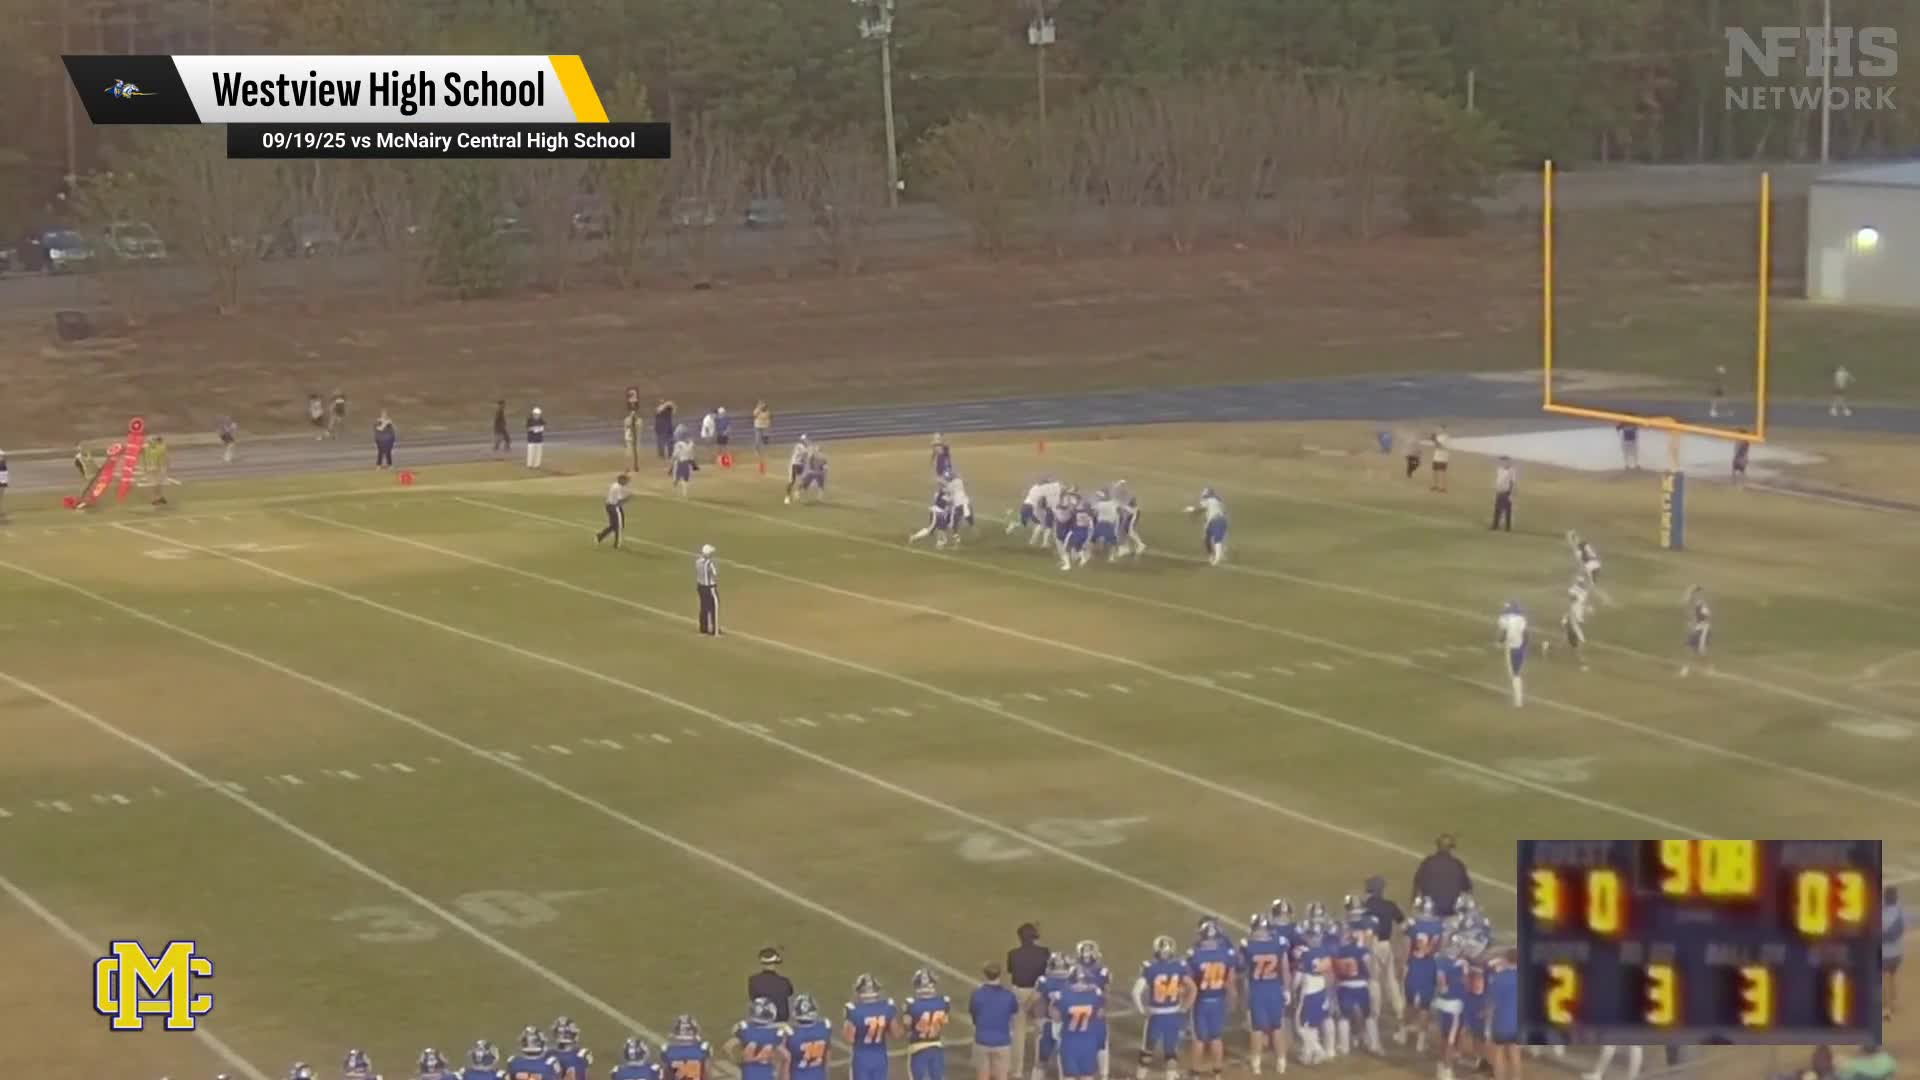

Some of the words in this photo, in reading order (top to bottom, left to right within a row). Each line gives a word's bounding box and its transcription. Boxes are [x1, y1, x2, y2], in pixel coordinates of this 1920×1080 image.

[1587, 869, 1619, 933] 0
[1796, 870, 1829, 935] 0
[1252, 954, 1278, 980] 72
[1547, 963, 1578, 1025] 2
[1646, 964, 1675, 1025] 3
[1740, 964, 1770, 1025] 3
[1829, 966, 1847, 1025] 1
[863, 1015, 887, 1044] 71
[1067, 1004, 1093, 1032] 77
